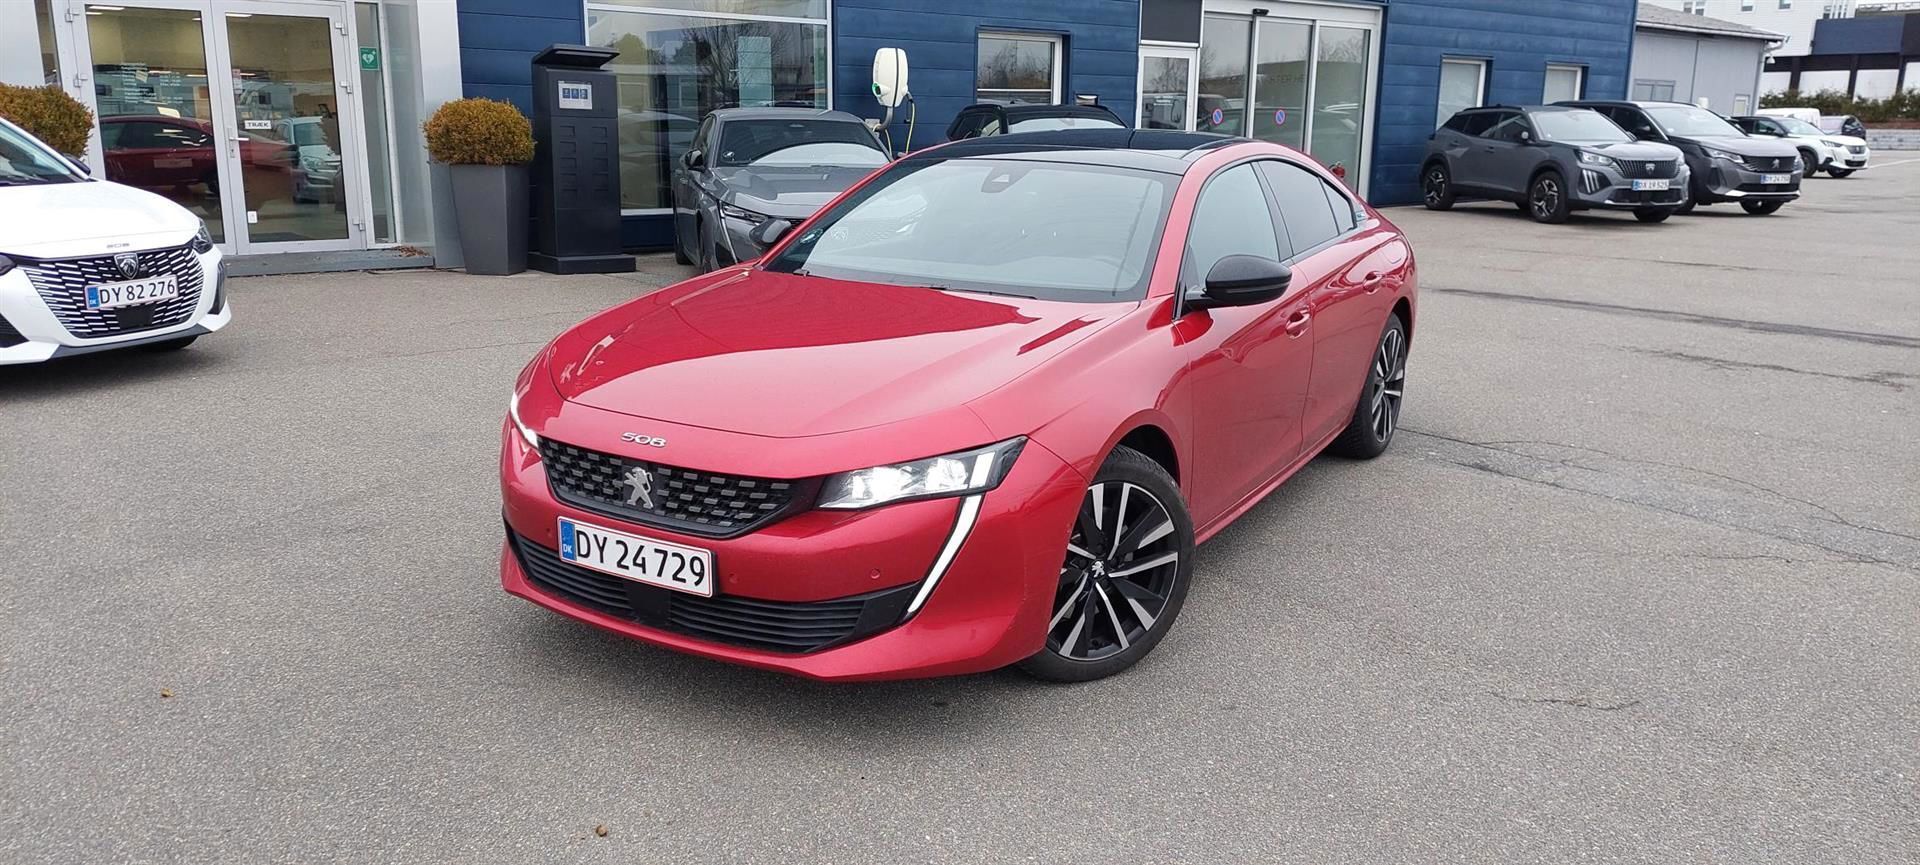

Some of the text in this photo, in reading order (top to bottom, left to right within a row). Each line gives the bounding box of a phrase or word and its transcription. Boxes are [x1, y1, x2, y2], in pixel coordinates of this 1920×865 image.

[100, 279, 175, 304] DY 82 276
[620, 431, 666, 448] 508
[562, 543, 573, 554] DK
[576, 529, 705, 586] DY 24 729
